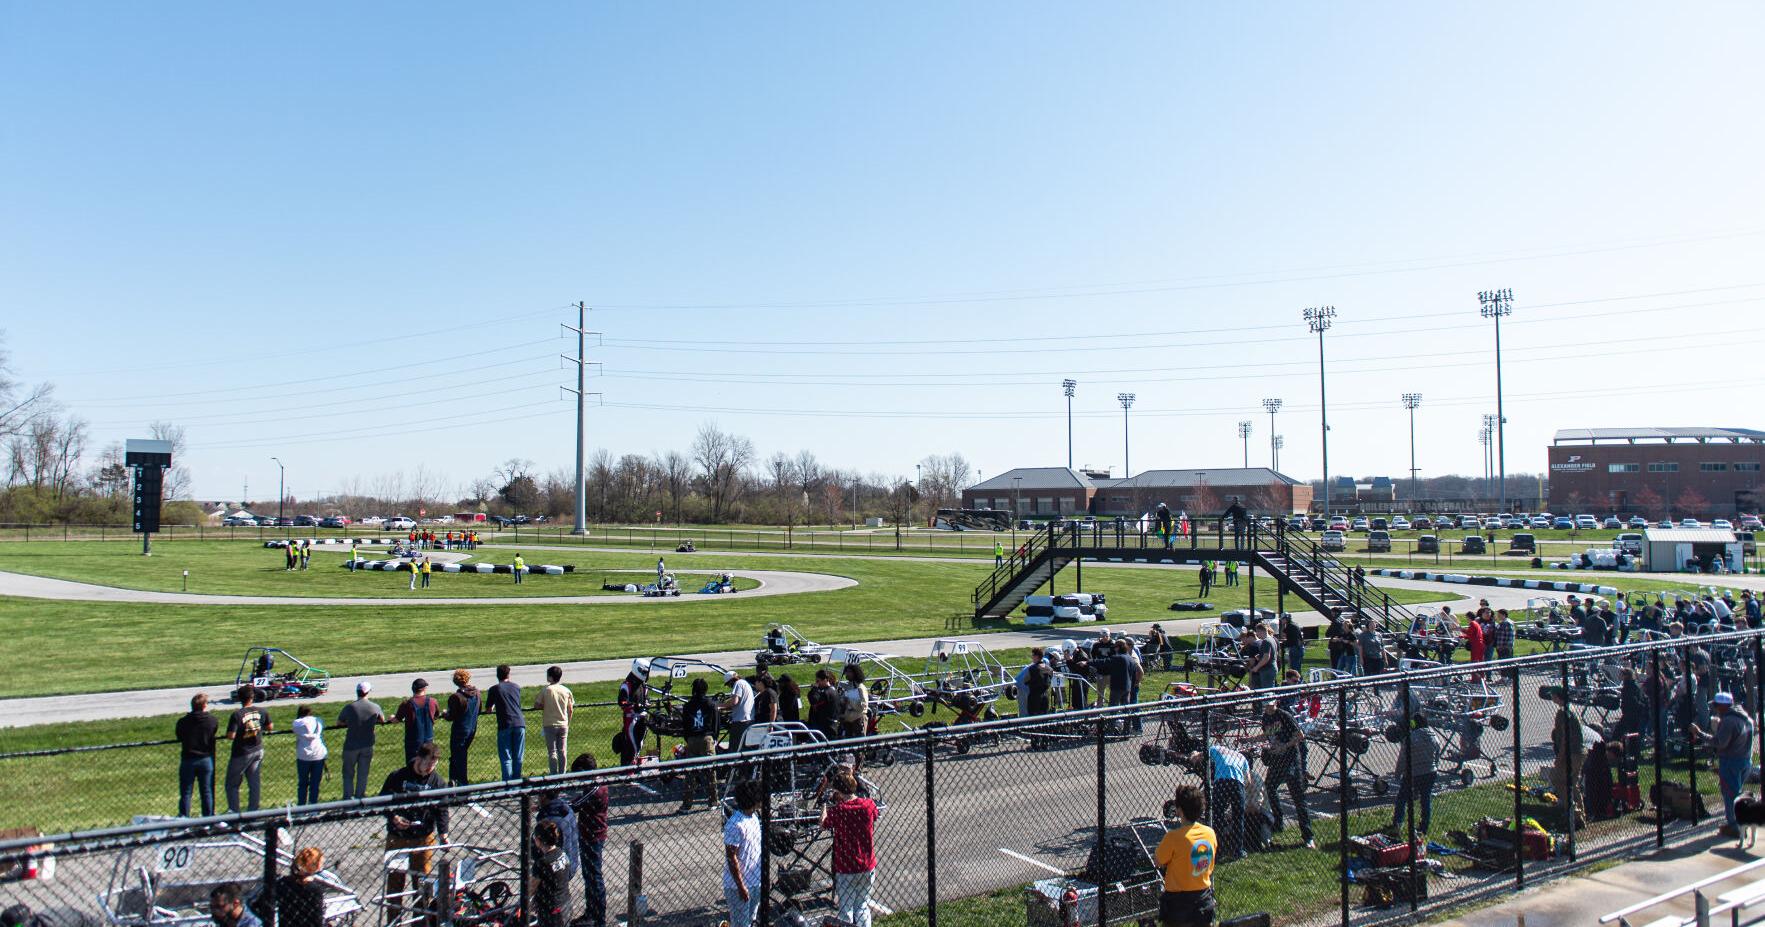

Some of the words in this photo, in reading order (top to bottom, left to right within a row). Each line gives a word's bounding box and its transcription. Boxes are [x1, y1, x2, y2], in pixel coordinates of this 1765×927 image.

[959, 644, 966, 652] 99
[848, 652, 860, 663] 86
[674, 664, 686, 677] 75
[1313, 671, 1320, 681] 13
[256, 678, 266, 686] 27
[164, 846, 189, 868] 90
